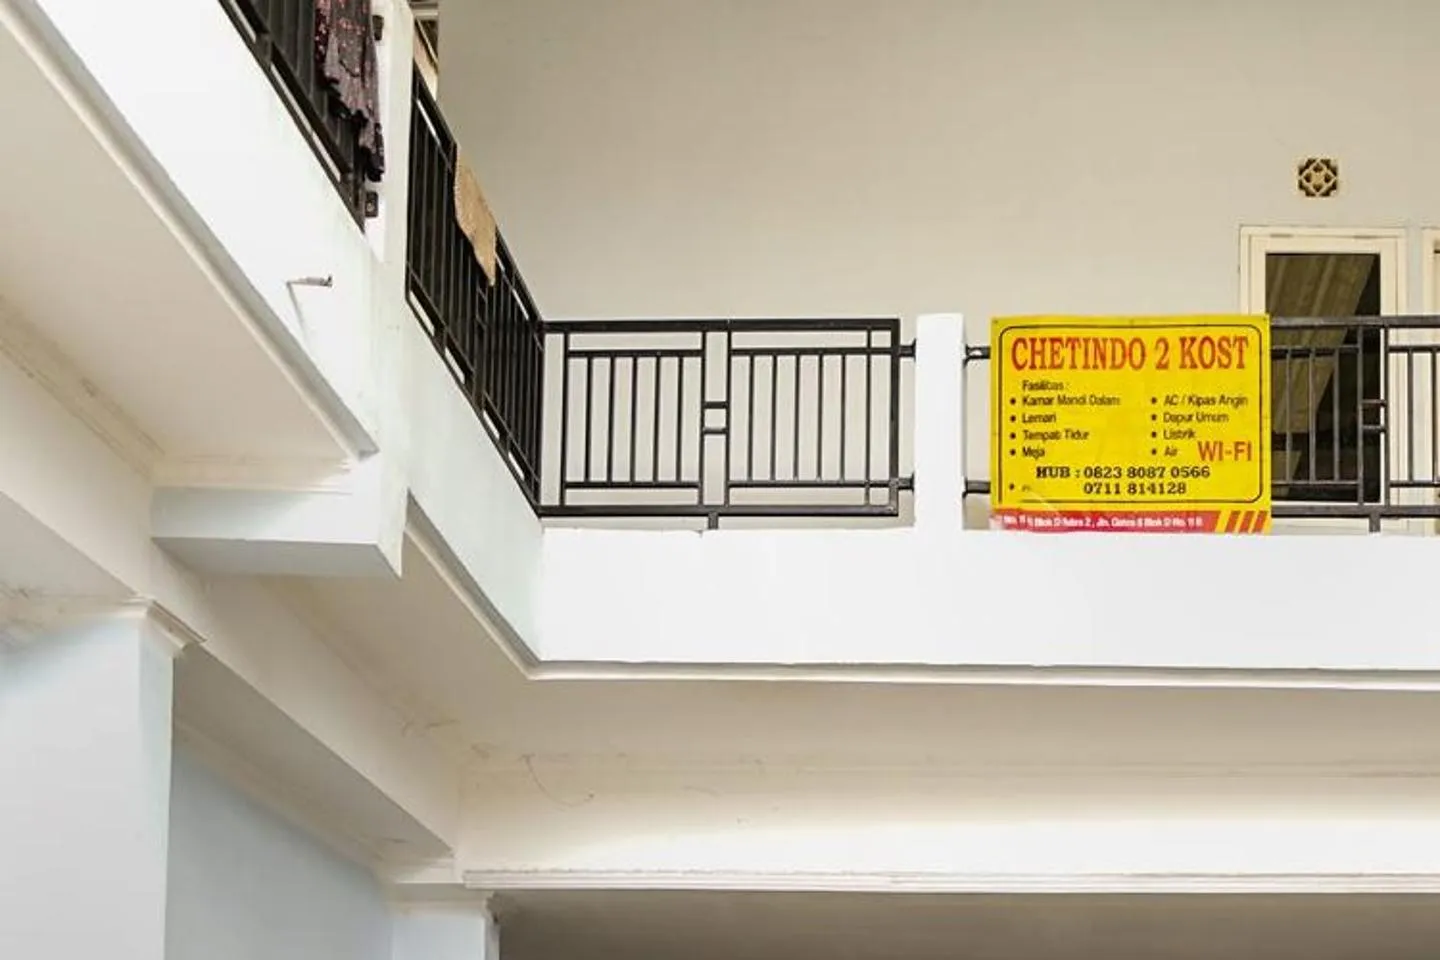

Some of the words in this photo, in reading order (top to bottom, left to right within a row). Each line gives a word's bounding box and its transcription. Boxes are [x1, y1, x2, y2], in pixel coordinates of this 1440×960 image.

[1011, 337, 1146, 371] CHETINDO
[1154, 336, 1169, 370] 2
[1178, 335, 1248, 370] KOST
[1022, 395, 1054, 406] Kamar
[1164, 395, 1179, 406] AC
[1188, 394, 1216, 407] Kipas
[1219, 395, 1248, 408] Angin
[1163, 412, 1193, 425] Dapur
[1197, 440, 1252, 462] WI-FI
[1036, 466, 1070, 478] HUB
[1084, 466, 1122, 479] 0823
[1170, 466, 1210, 479] 0566
[1084, 482, 1120, 494] 0711
